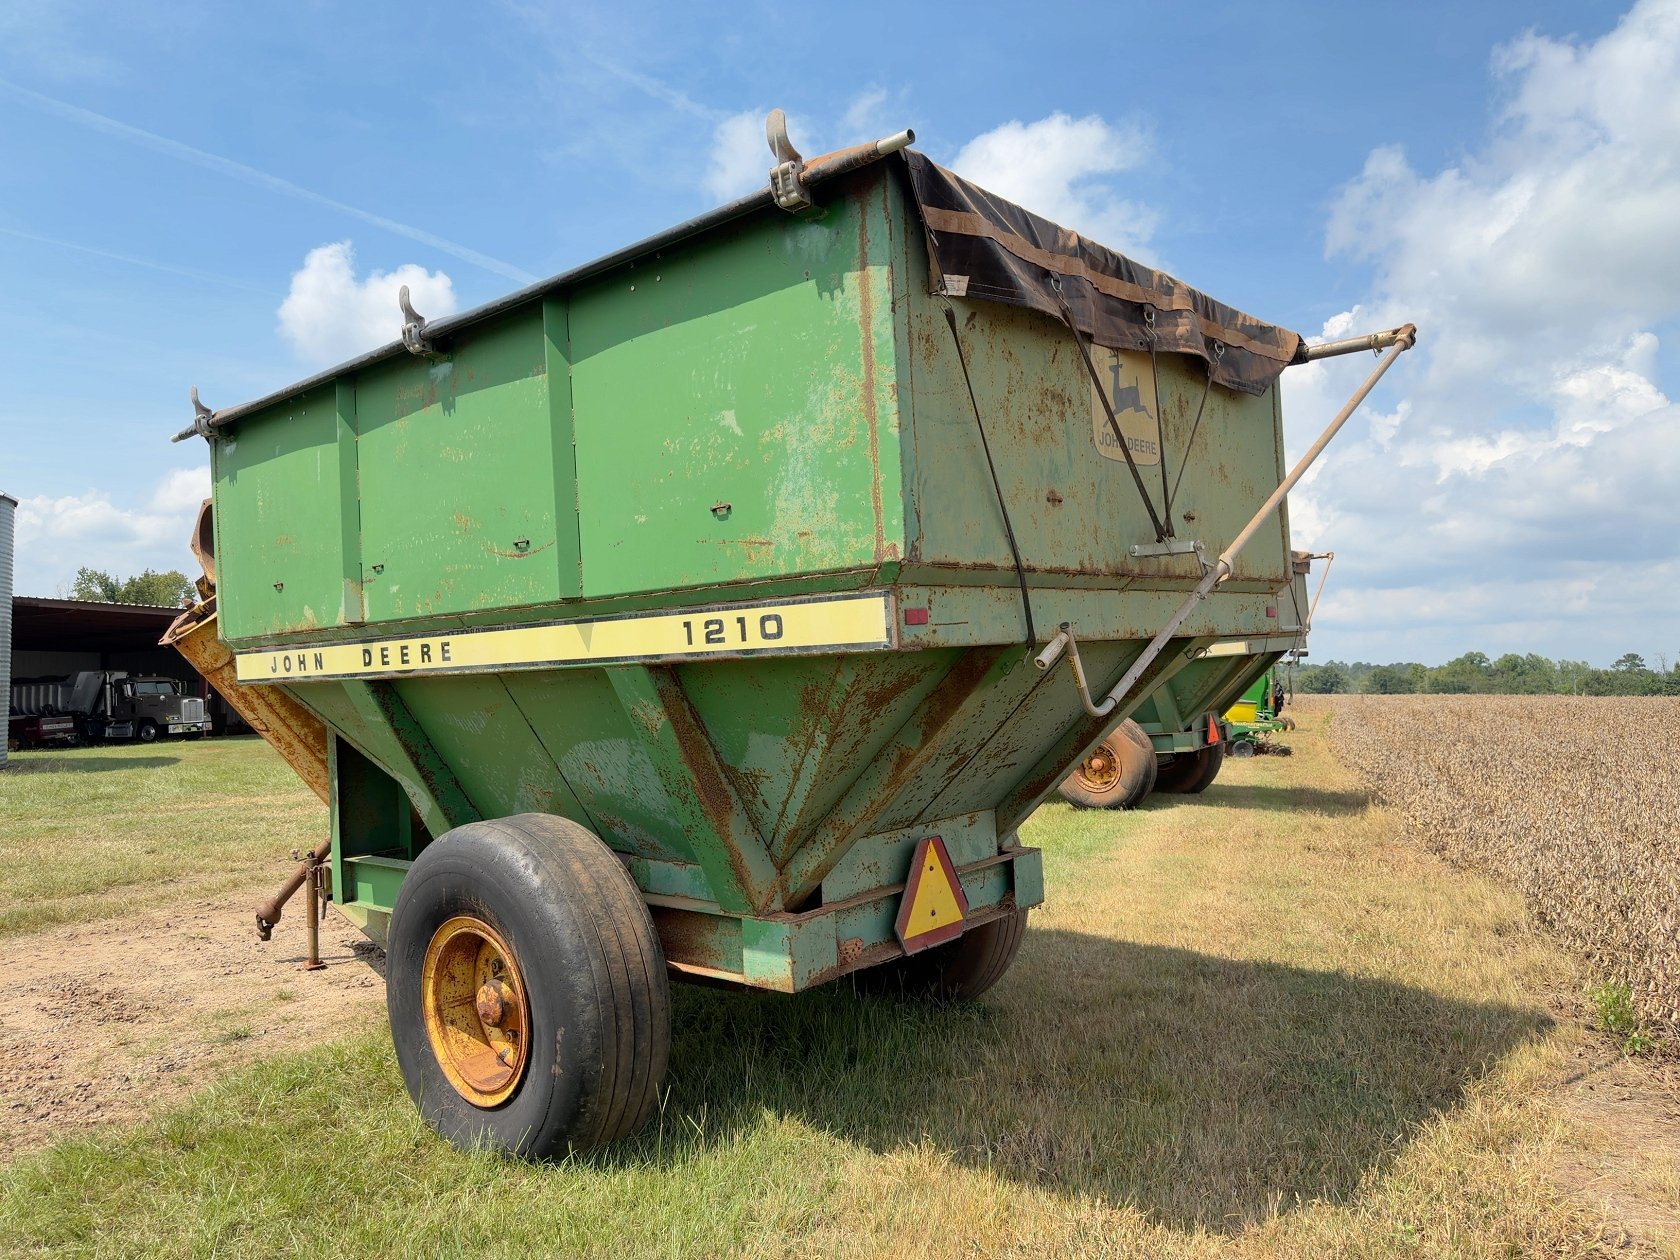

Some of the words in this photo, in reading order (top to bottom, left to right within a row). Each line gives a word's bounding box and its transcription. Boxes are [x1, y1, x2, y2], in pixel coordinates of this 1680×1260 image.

[1100, 432, 1125, 449] JOH
[1128, 437, 1157, 455] DEERE
[682, 613, 784, 646] 1210
[270, 652, 323, 674] JOHN
[361, 641, 451, 667] DEERE
